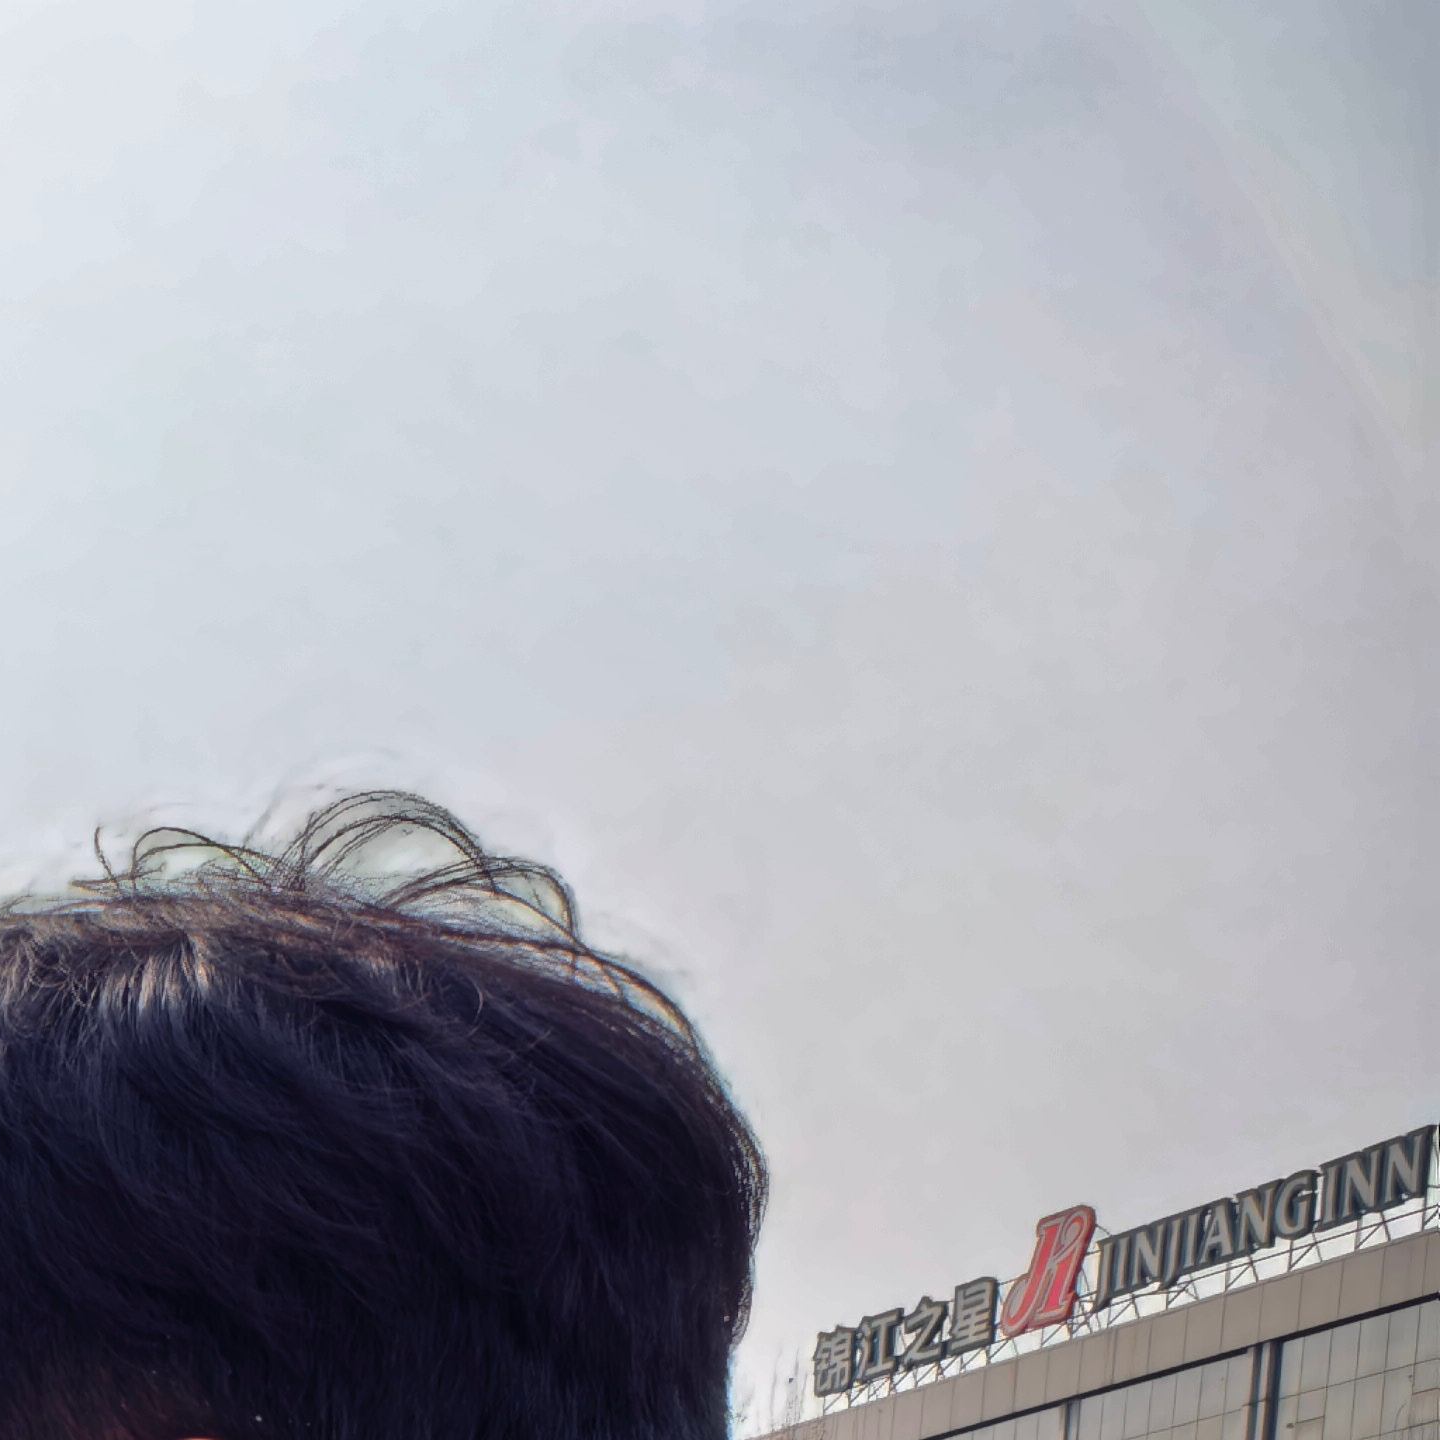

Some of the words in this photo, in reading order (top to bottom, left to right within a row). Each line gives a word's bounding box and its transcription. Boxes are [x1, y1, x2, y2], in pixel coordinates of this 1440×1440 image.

[1095, 1170, 1318, 1308] JINJIANG
[1320, 1126, 1436, 1230] INN
[814, 1277, 997, 1397] 锦江之星
